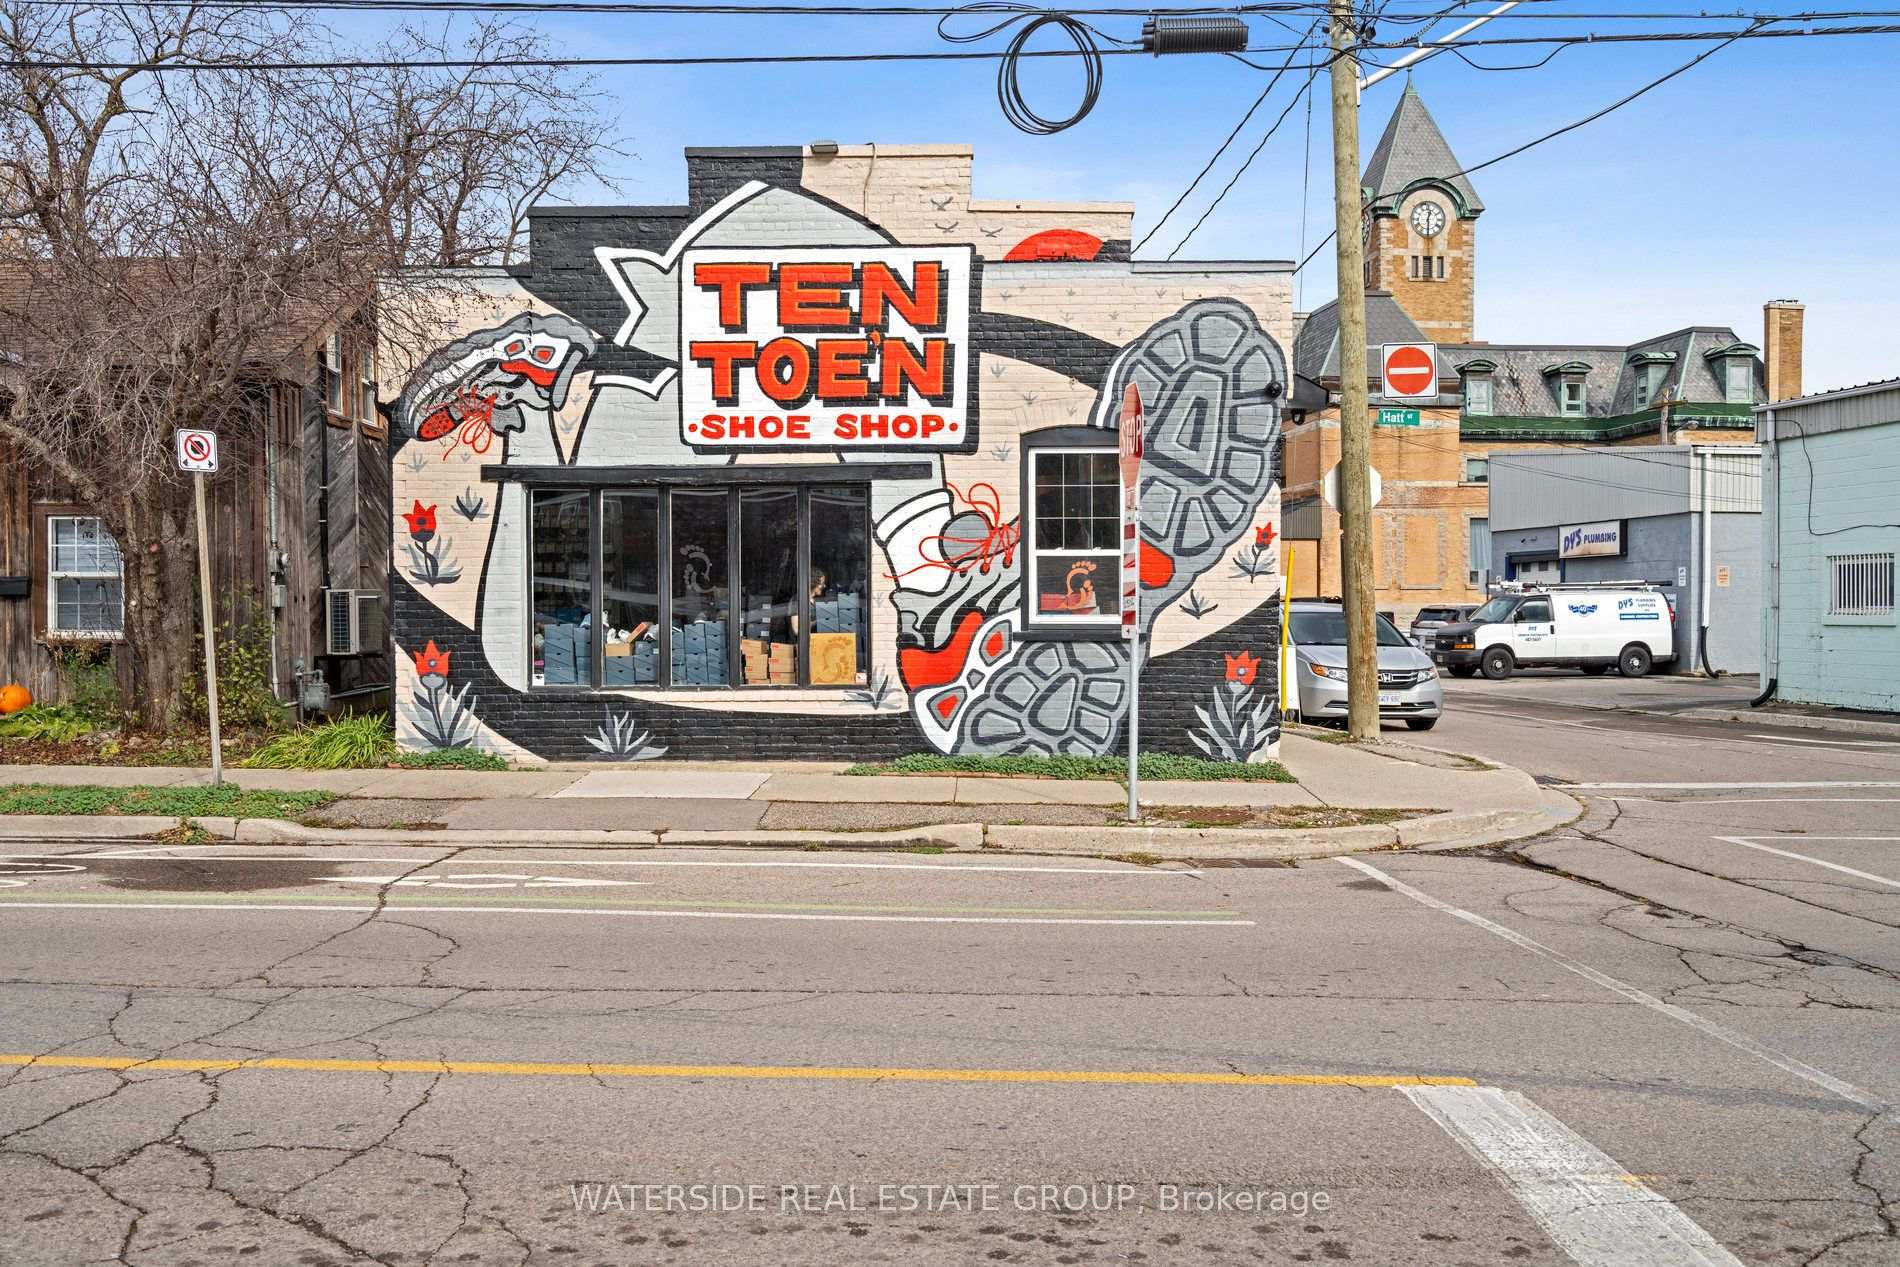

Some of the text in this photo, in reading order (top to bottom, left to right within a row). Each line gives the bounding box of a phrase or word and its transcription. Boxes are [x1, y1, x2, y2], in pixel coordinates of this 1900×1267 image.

[693, 261, 948, 333] TEN
[689, 330, 955, 408] TOE'N
[700, 413, 945, 439] SHOE SHOP
[1383, 411, 1404, 423] Hatt
[1120, 414, 1142, 458] STOP
[1583, 532, 1617, 545] PLUMBING
